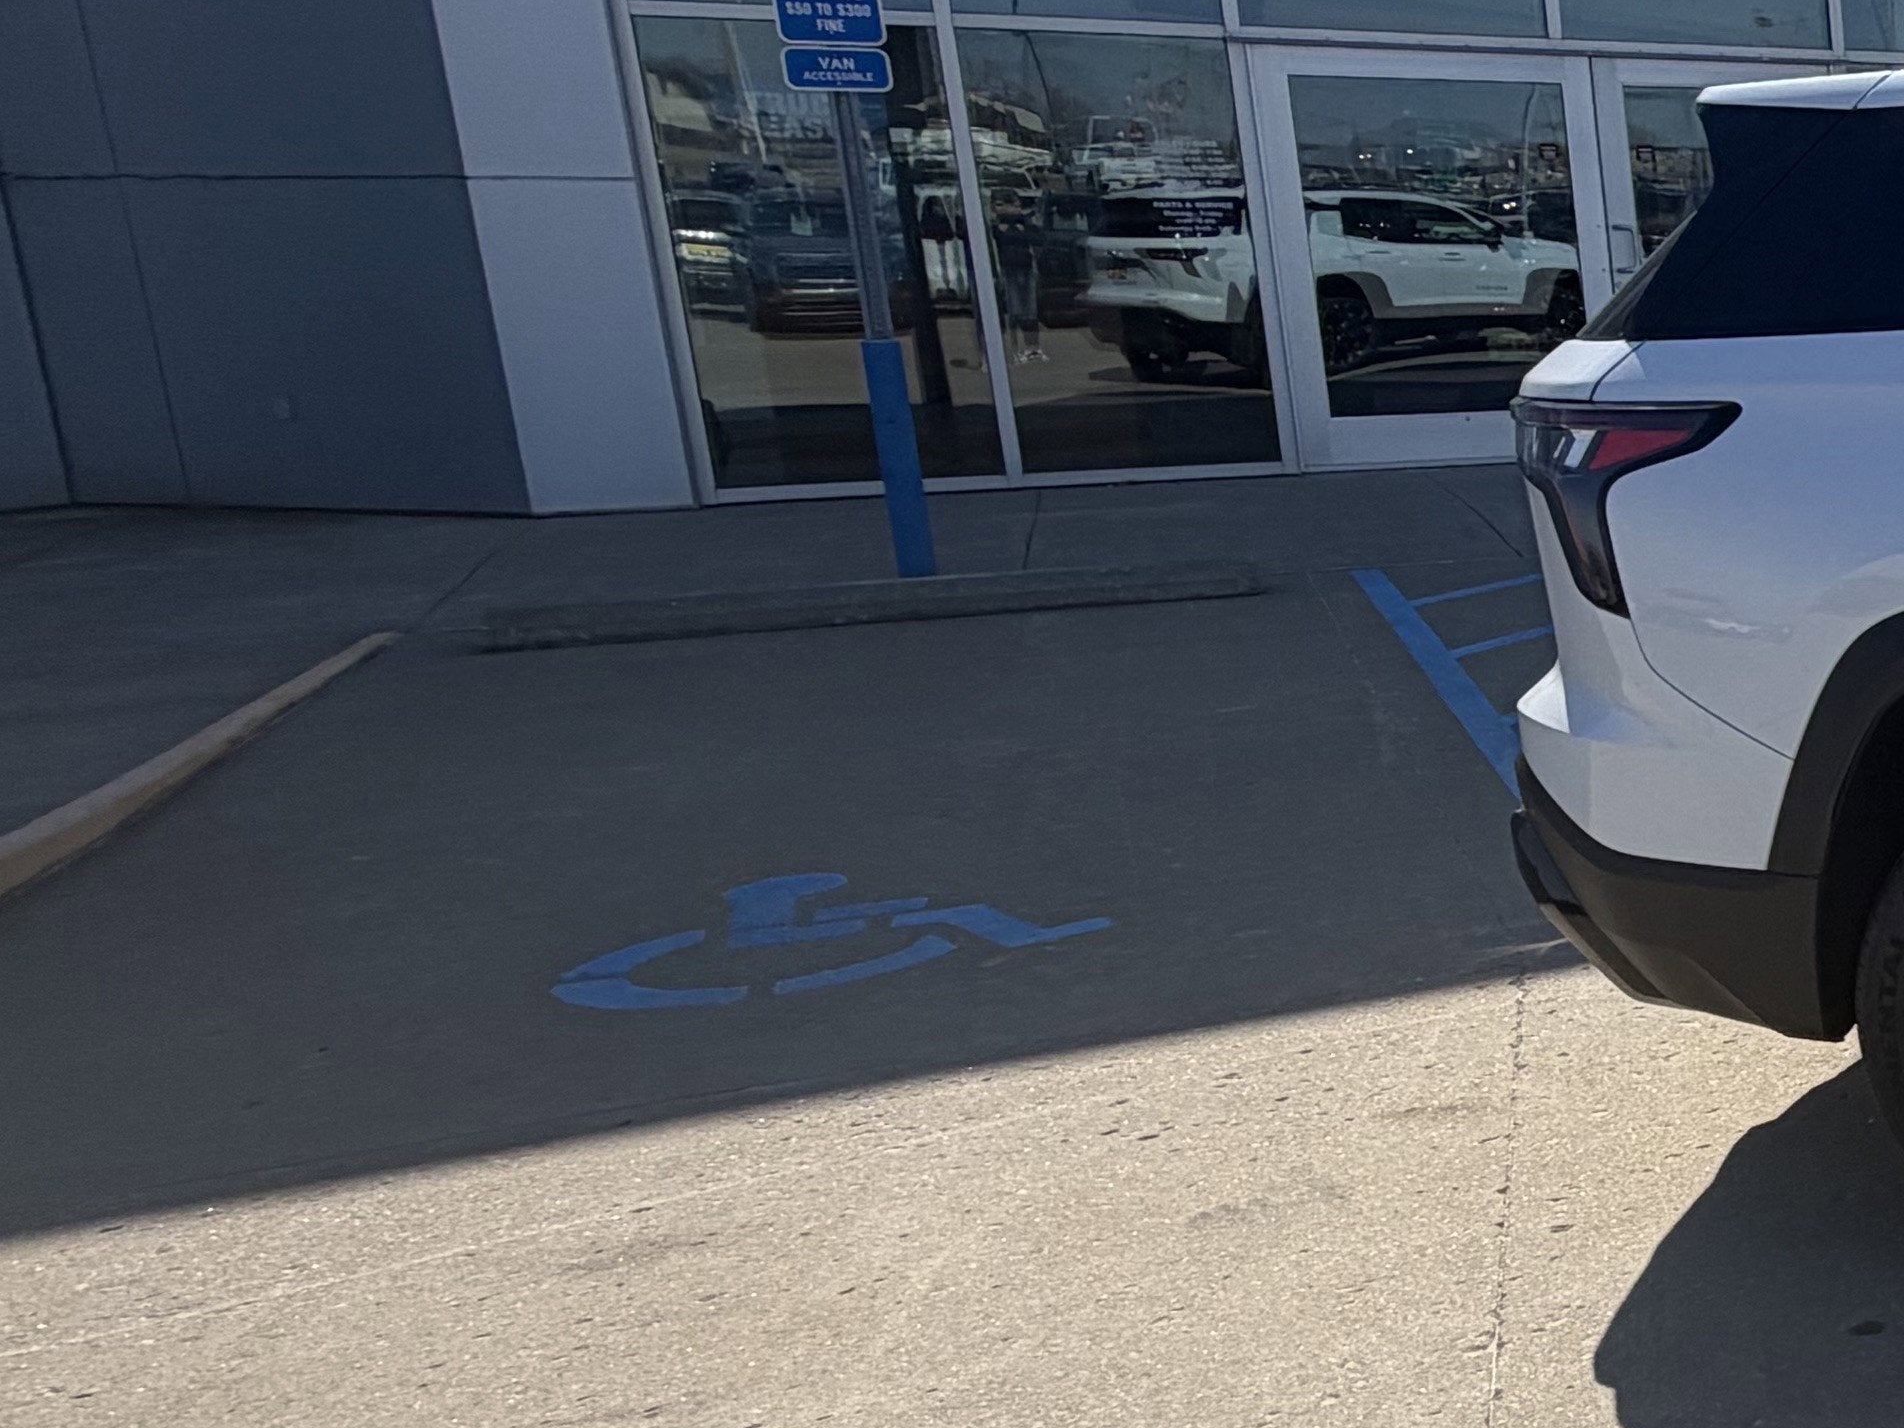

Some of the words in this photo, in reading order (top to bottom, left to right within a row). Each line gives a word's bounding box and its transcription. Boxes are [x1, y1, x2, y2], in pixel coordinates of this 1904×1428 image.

[785, 1, 813, 16] $50
[815, 2, 833, 16] TO
[836, 3, 872, 18] $300
[816, 18, 846, 33] FINE
[817, 56, 856, 71] VAN
[803, 70, 874, 82] ACCESSIBLE
